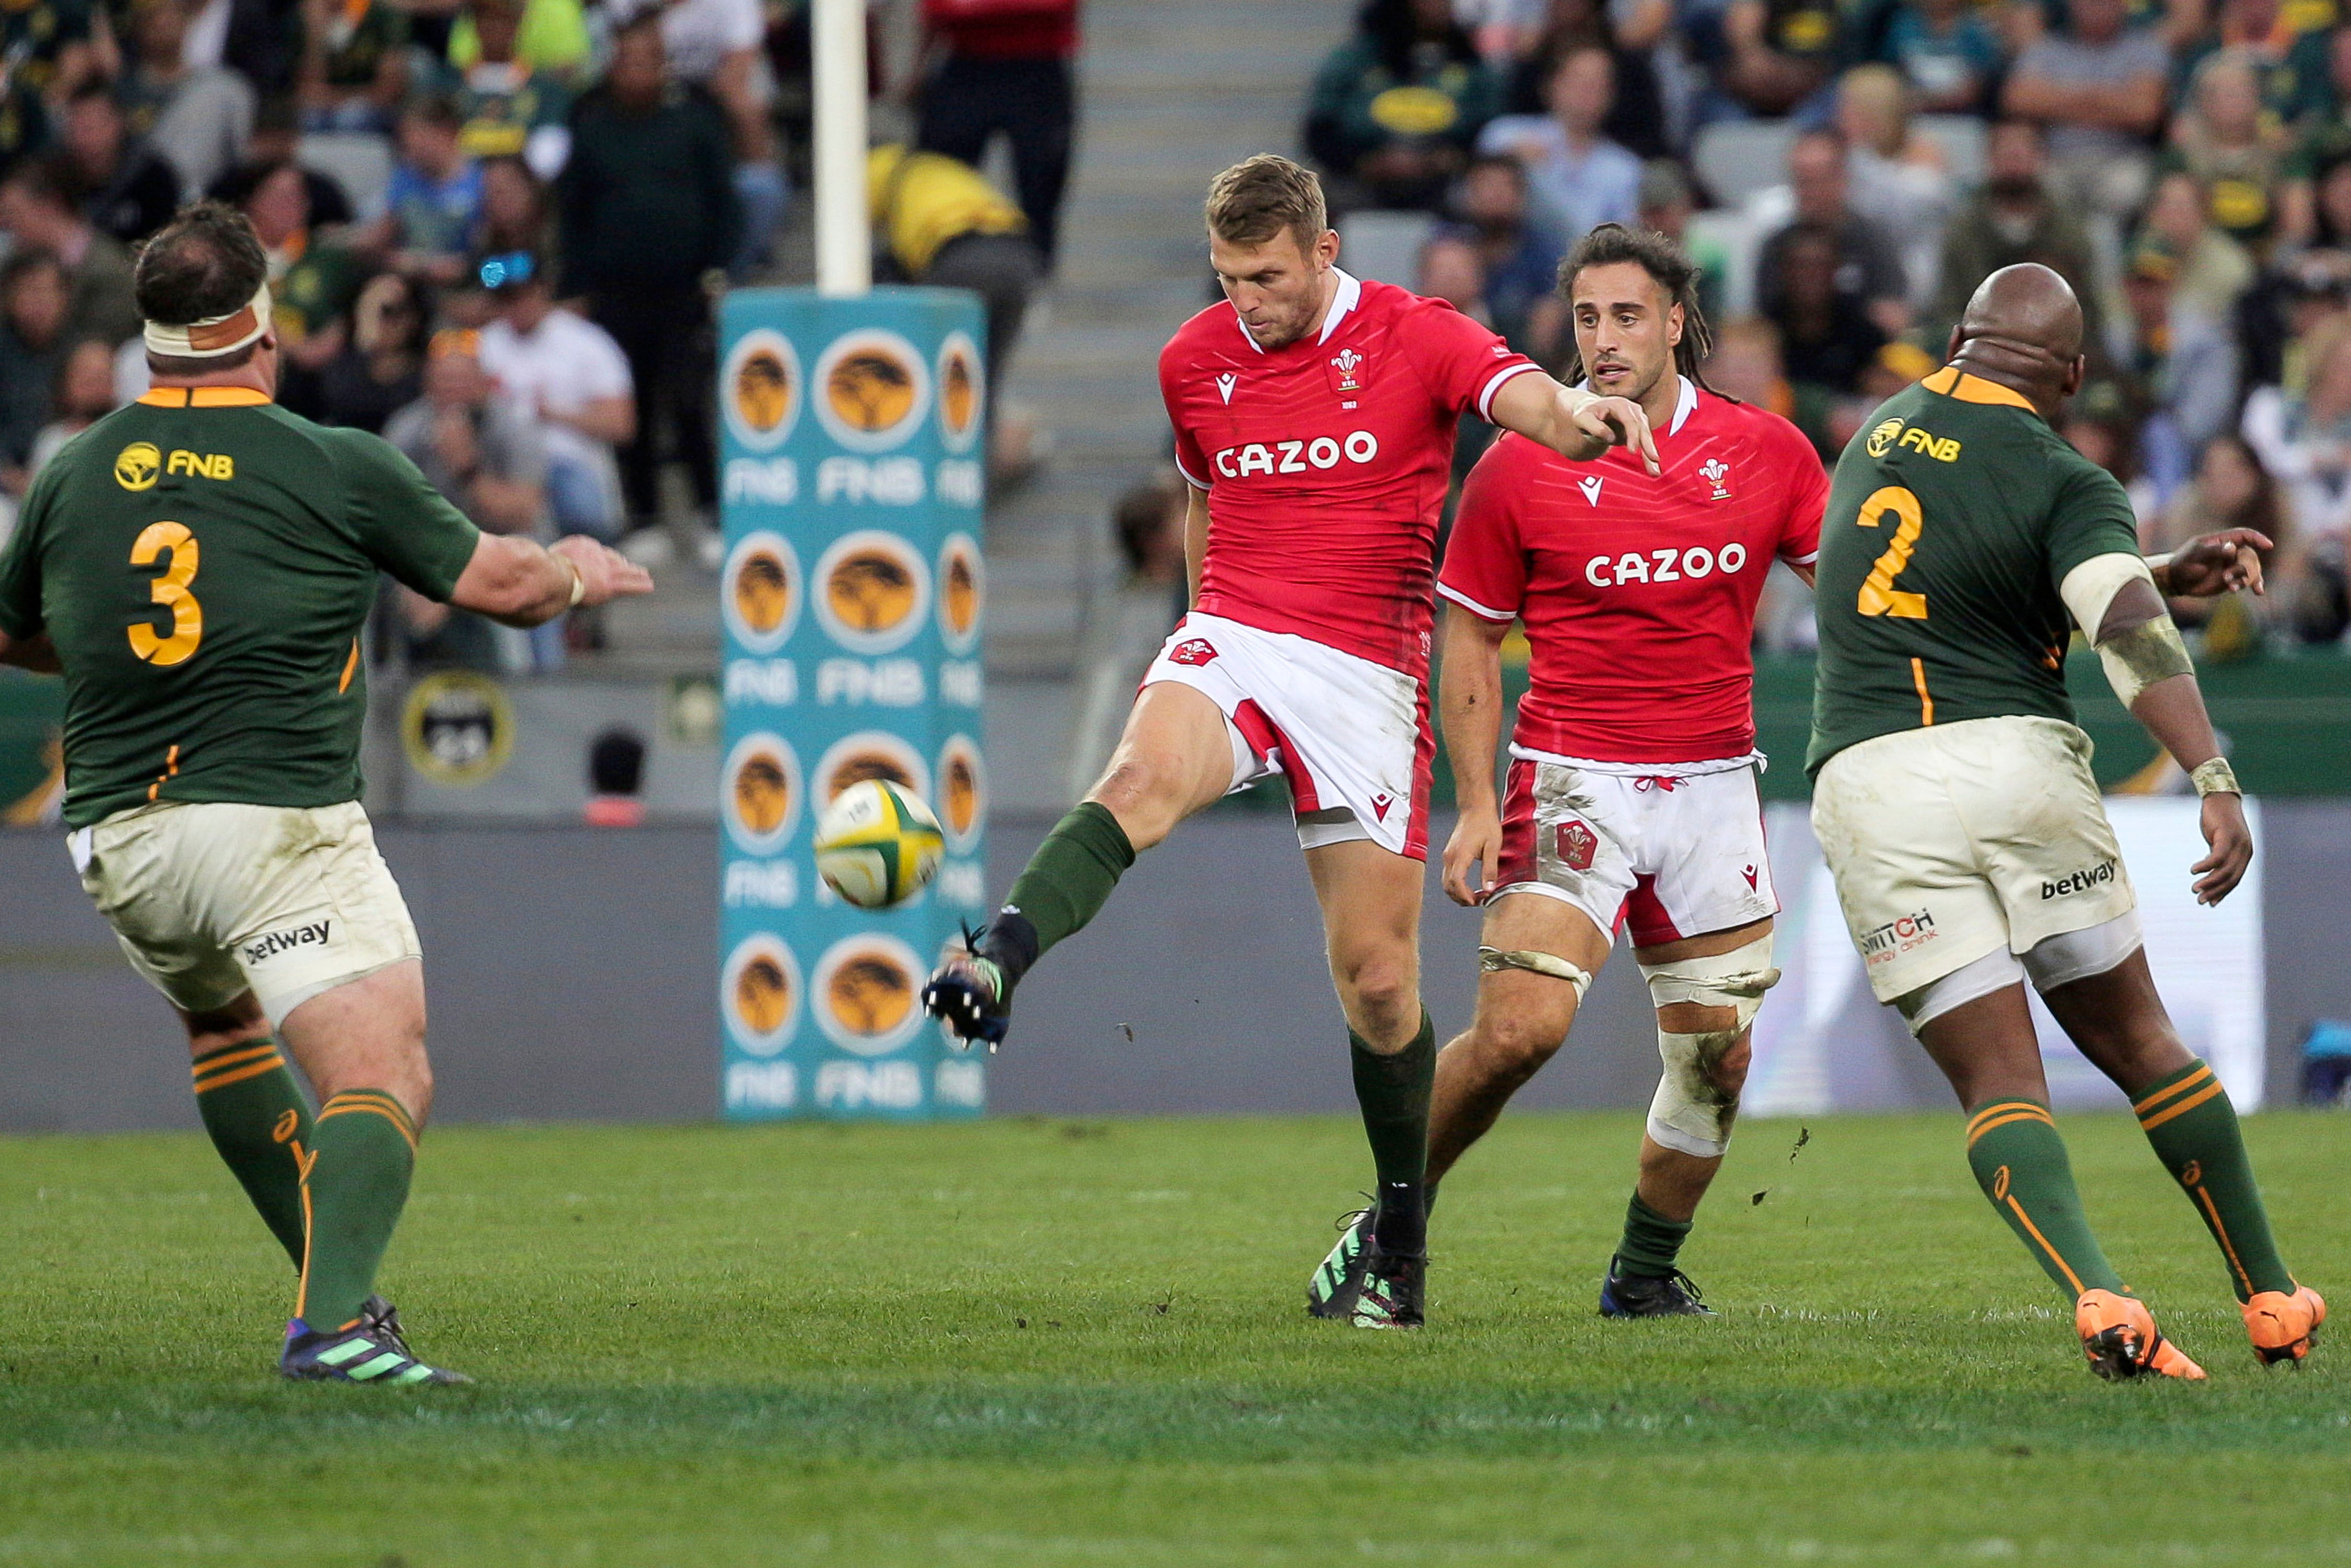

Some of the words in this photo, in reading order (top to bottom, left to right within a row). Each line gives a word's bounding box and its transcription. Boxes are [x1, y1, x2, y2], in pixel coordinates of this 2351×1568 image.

[167, 449, 234, 481] FNB
[1216, 430, 1378, 478] CAZOO
[1898, 427, 1962, 463] FNB
[1585, 542, 1747, 587] CAZOO
[1856, 486, 1928, 619] 2
[127, 521, 203, 666] 3
[2041, 858, 2116, 900] betway
